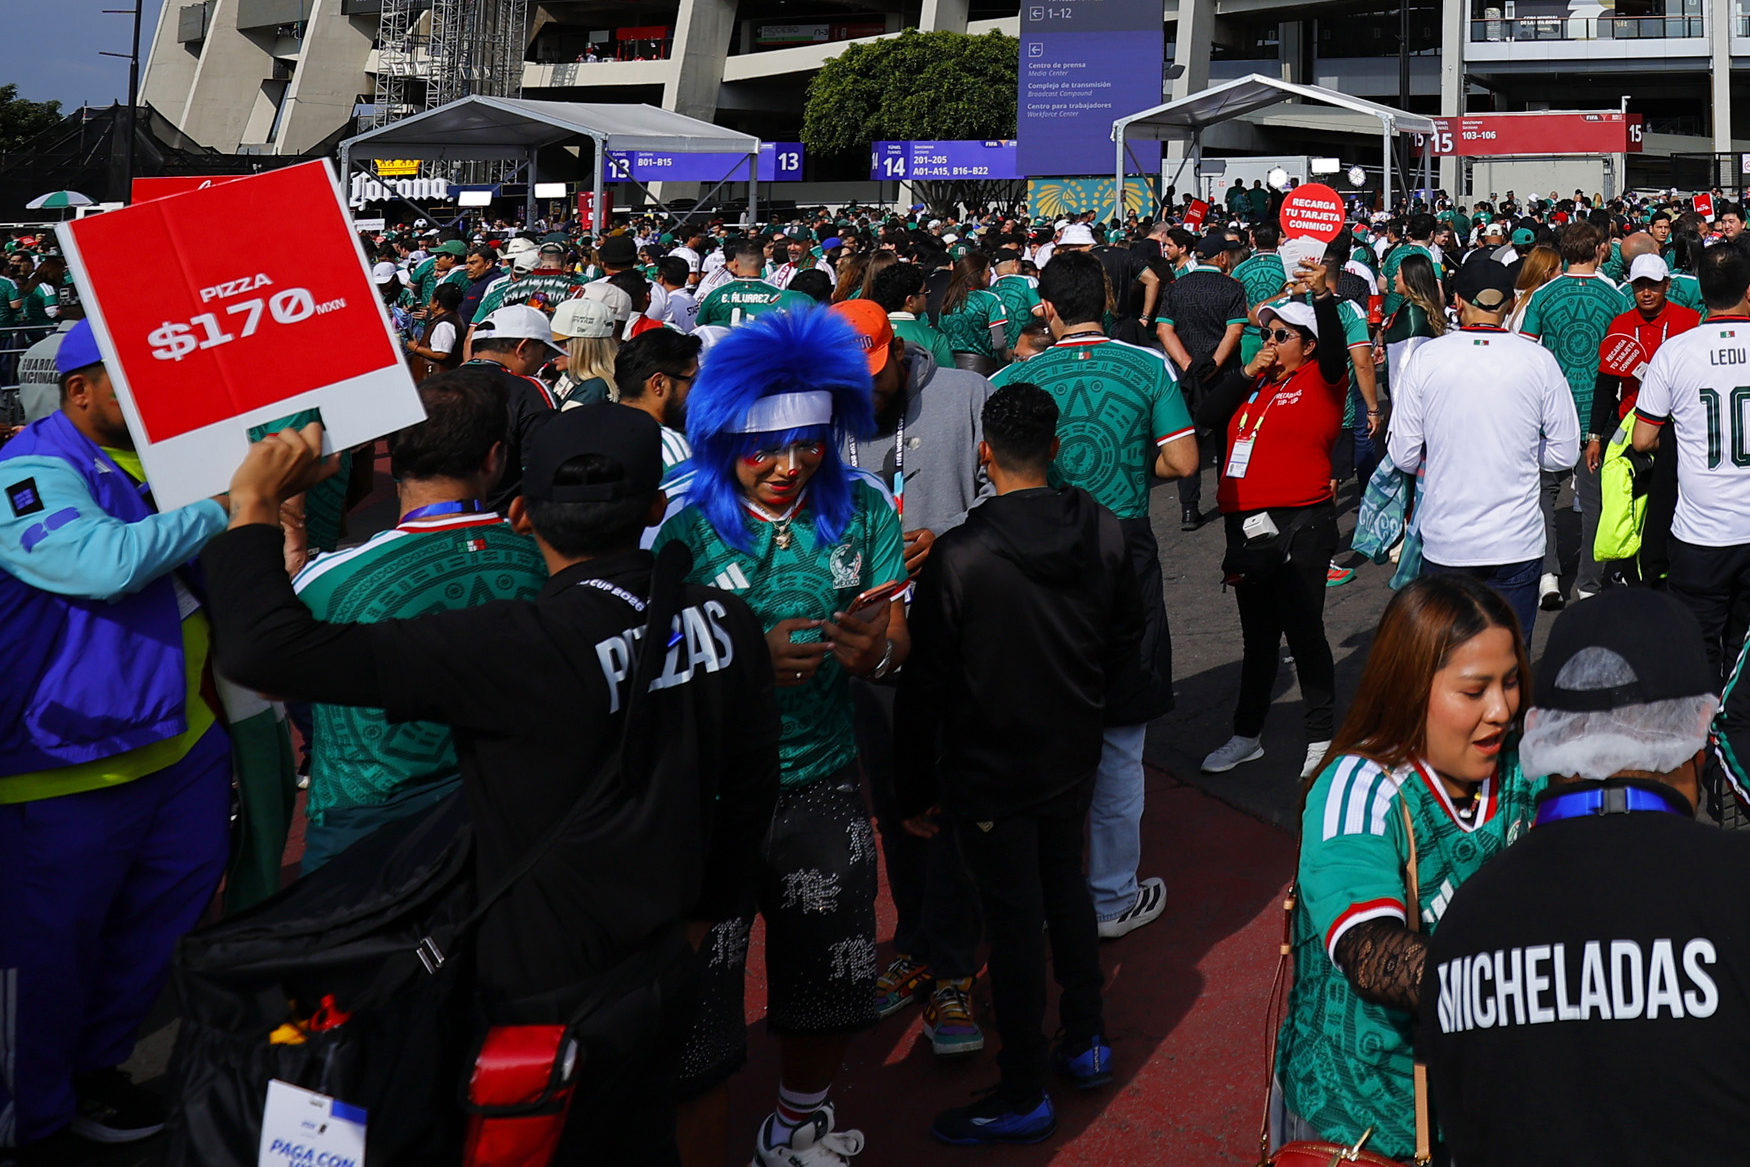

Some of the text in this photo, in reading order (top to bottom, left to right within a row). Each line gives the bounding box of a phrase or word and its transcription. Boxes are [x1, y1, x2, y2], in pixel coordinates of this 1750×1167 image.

[1063, 62, 1086, 70] prensa
[1059, 90, 1093, 98] Compound
[1068, 102, 1112, 110] trabajadores
[1430, 132, 1454, 153] 15
[1629, 124, 1642, 143] 15
[608, 158, 630, 179] 13
[778, 152, 800, 171] 13
[883, 157, 906, 177] 14
[349, 170, 450, 212] Corona
[1292, 197, 1336, 211] RECARGA
[1285, 207, 1341, 223] TU TARJETA
[1288, 219, 1334, 233] CONMIGO
[199, 272, 274, 304] PIZZA
[720, 290, 770, 304] E. ÁLVAREZ
[146, 287, 348, 363] $170 MXN
[1605, 339, 1627, 363] RECARGA
[1609, 341, 1637, 370] TU TARJETA
[1619, 349, 1641, 372] CONMIGO
[1710, 347, 1747, 366] LEDU
[833, 578, 860, 589] MÉXICO
[589, 578, 645, 612] CUP 2026
[1437, 937, 1720, 1034] MICHELADAS
[269, 1137, 315, 1161] PAGA
